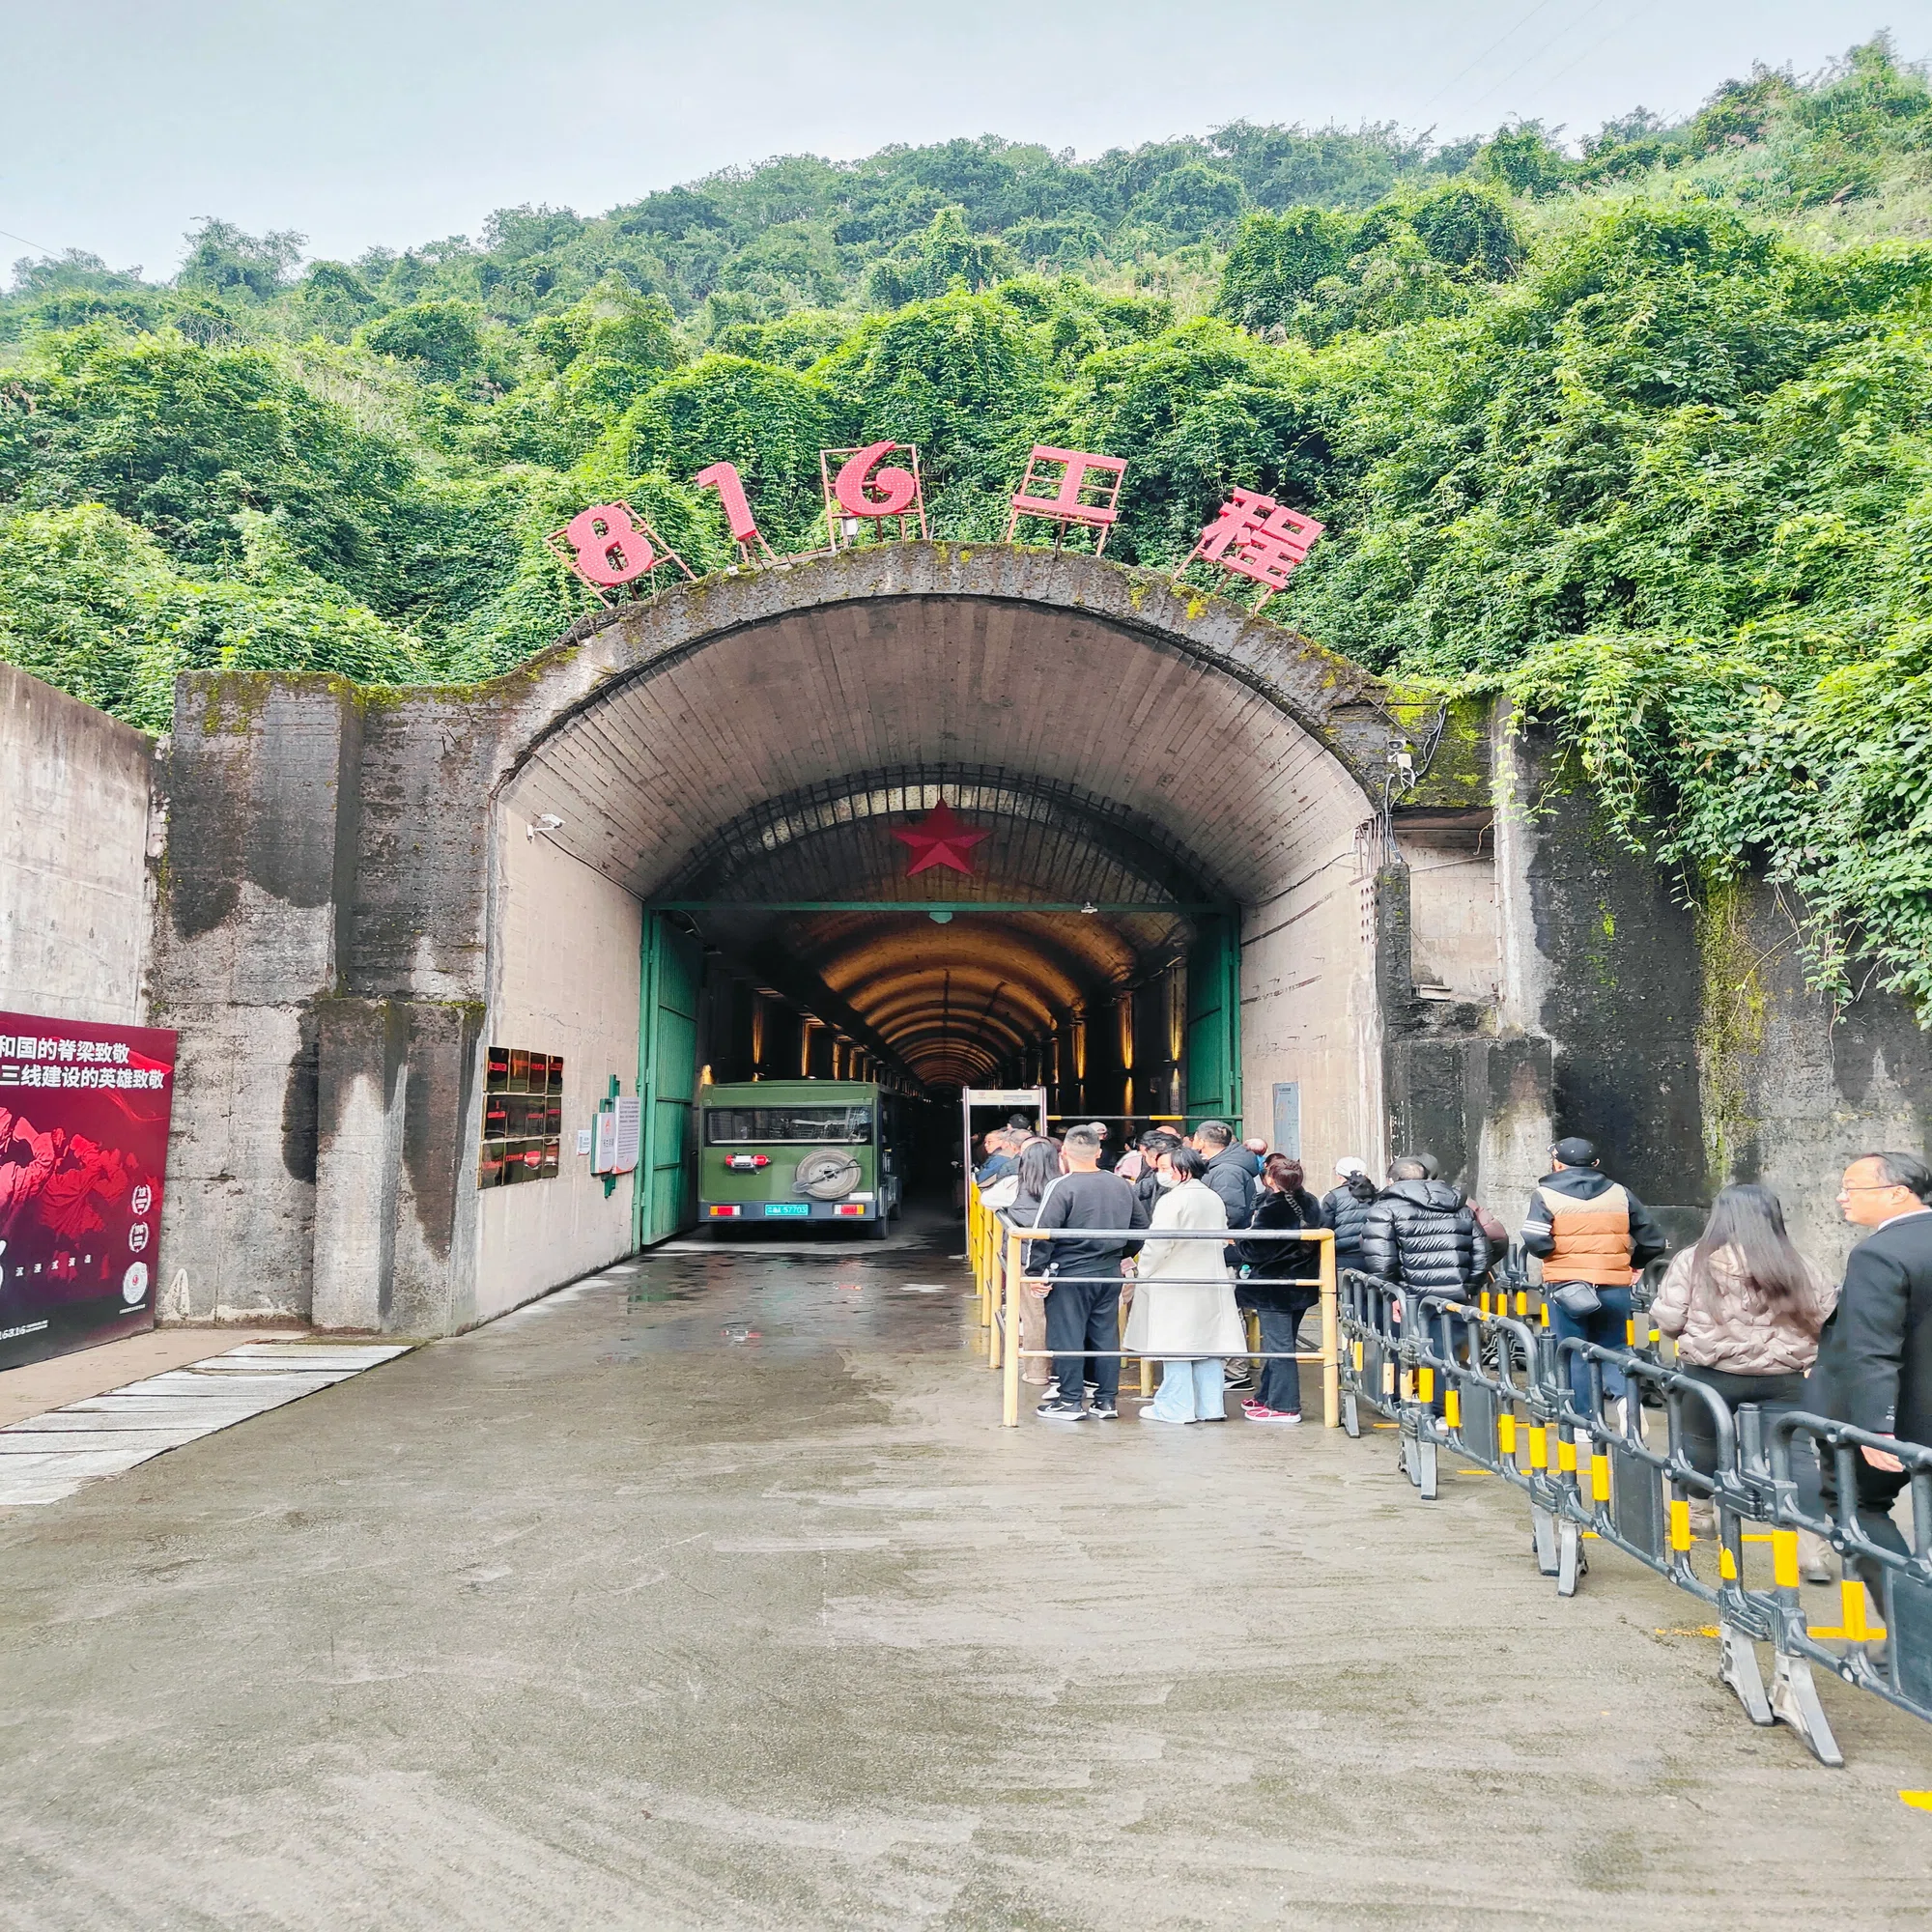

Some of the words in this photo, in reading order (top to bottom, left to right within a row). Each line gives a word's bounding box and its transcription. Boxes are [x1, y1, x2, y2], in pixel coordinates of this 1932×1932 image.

[566, 440, 1326, 590] 816工程
[0, 1035, 129, 1064] 和国的脊梁致敬
[0, 1064, 165, 1090] 三线建设的英雄致敬
